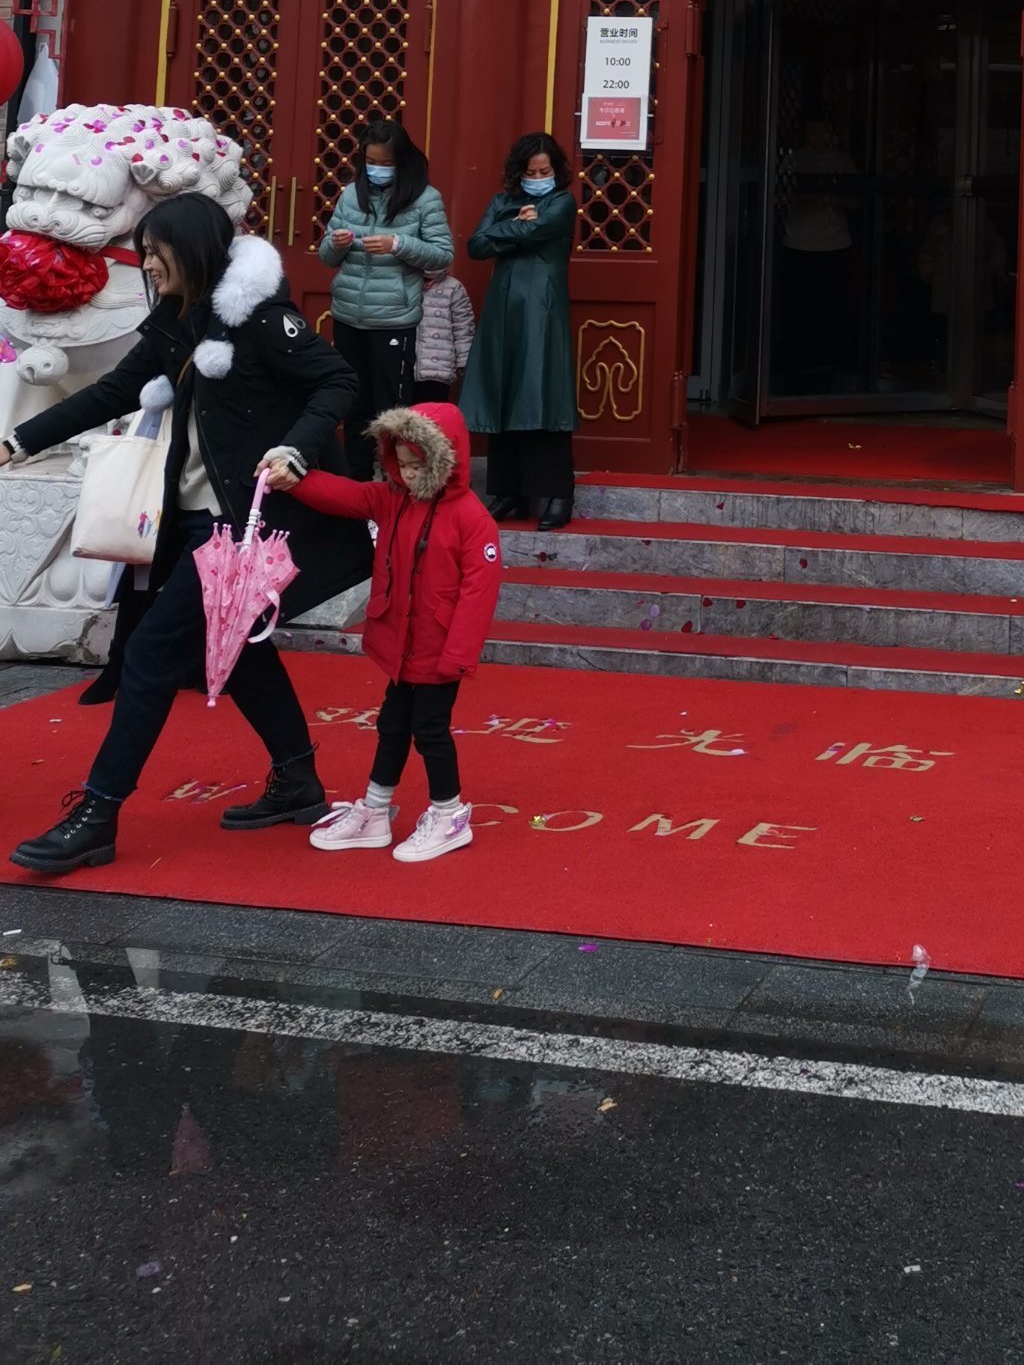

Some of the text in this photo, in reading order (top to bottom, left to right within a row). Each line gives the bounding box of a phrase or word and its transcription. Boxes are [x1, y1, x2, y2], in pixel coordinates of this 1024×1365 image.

[600, 27, 638, 38] 营业时间
[605, 57, 631, 67] 10:00
[603, 79, 630, 89] 22:00
